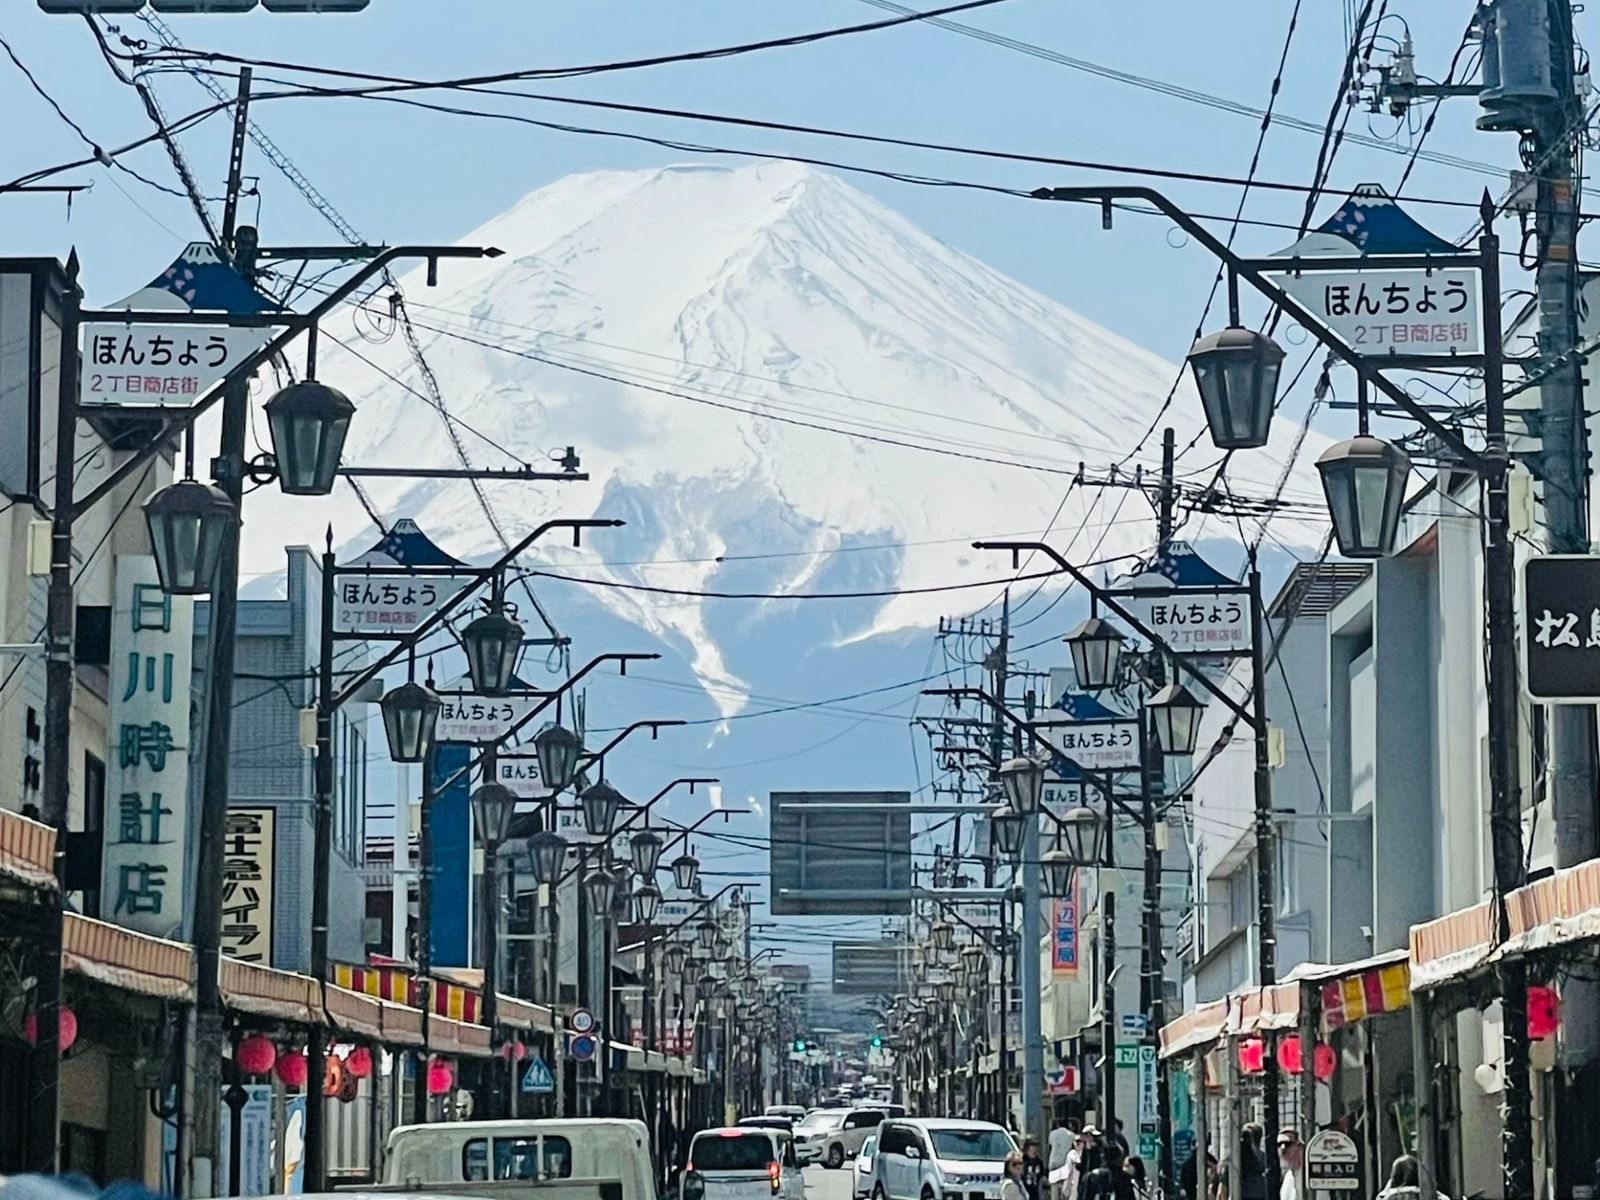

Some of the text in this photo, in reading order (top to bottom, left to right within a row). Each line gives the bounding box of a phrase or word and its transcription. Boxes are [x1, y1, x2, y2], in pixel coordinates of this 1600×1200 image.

[1325, 280, 1468, 316] ほんちょう
[1355, 321, 1468, 344] 2丁目商店街
[93, 334, 229, 367] ほんちょう
[91, 373, 199, 396] 2丁目商店街
[342, 583, 437, 606] ほんちょう
[1151, 602, 1242, 625] ほんちょう
[441, 702, 514, 721] ほんちょう
[114, 582, 174, 916] 日川時計店
[1063, 730, 1133, 749] ほんちょう
[1045, 788, 1101, 803] ほんちう
